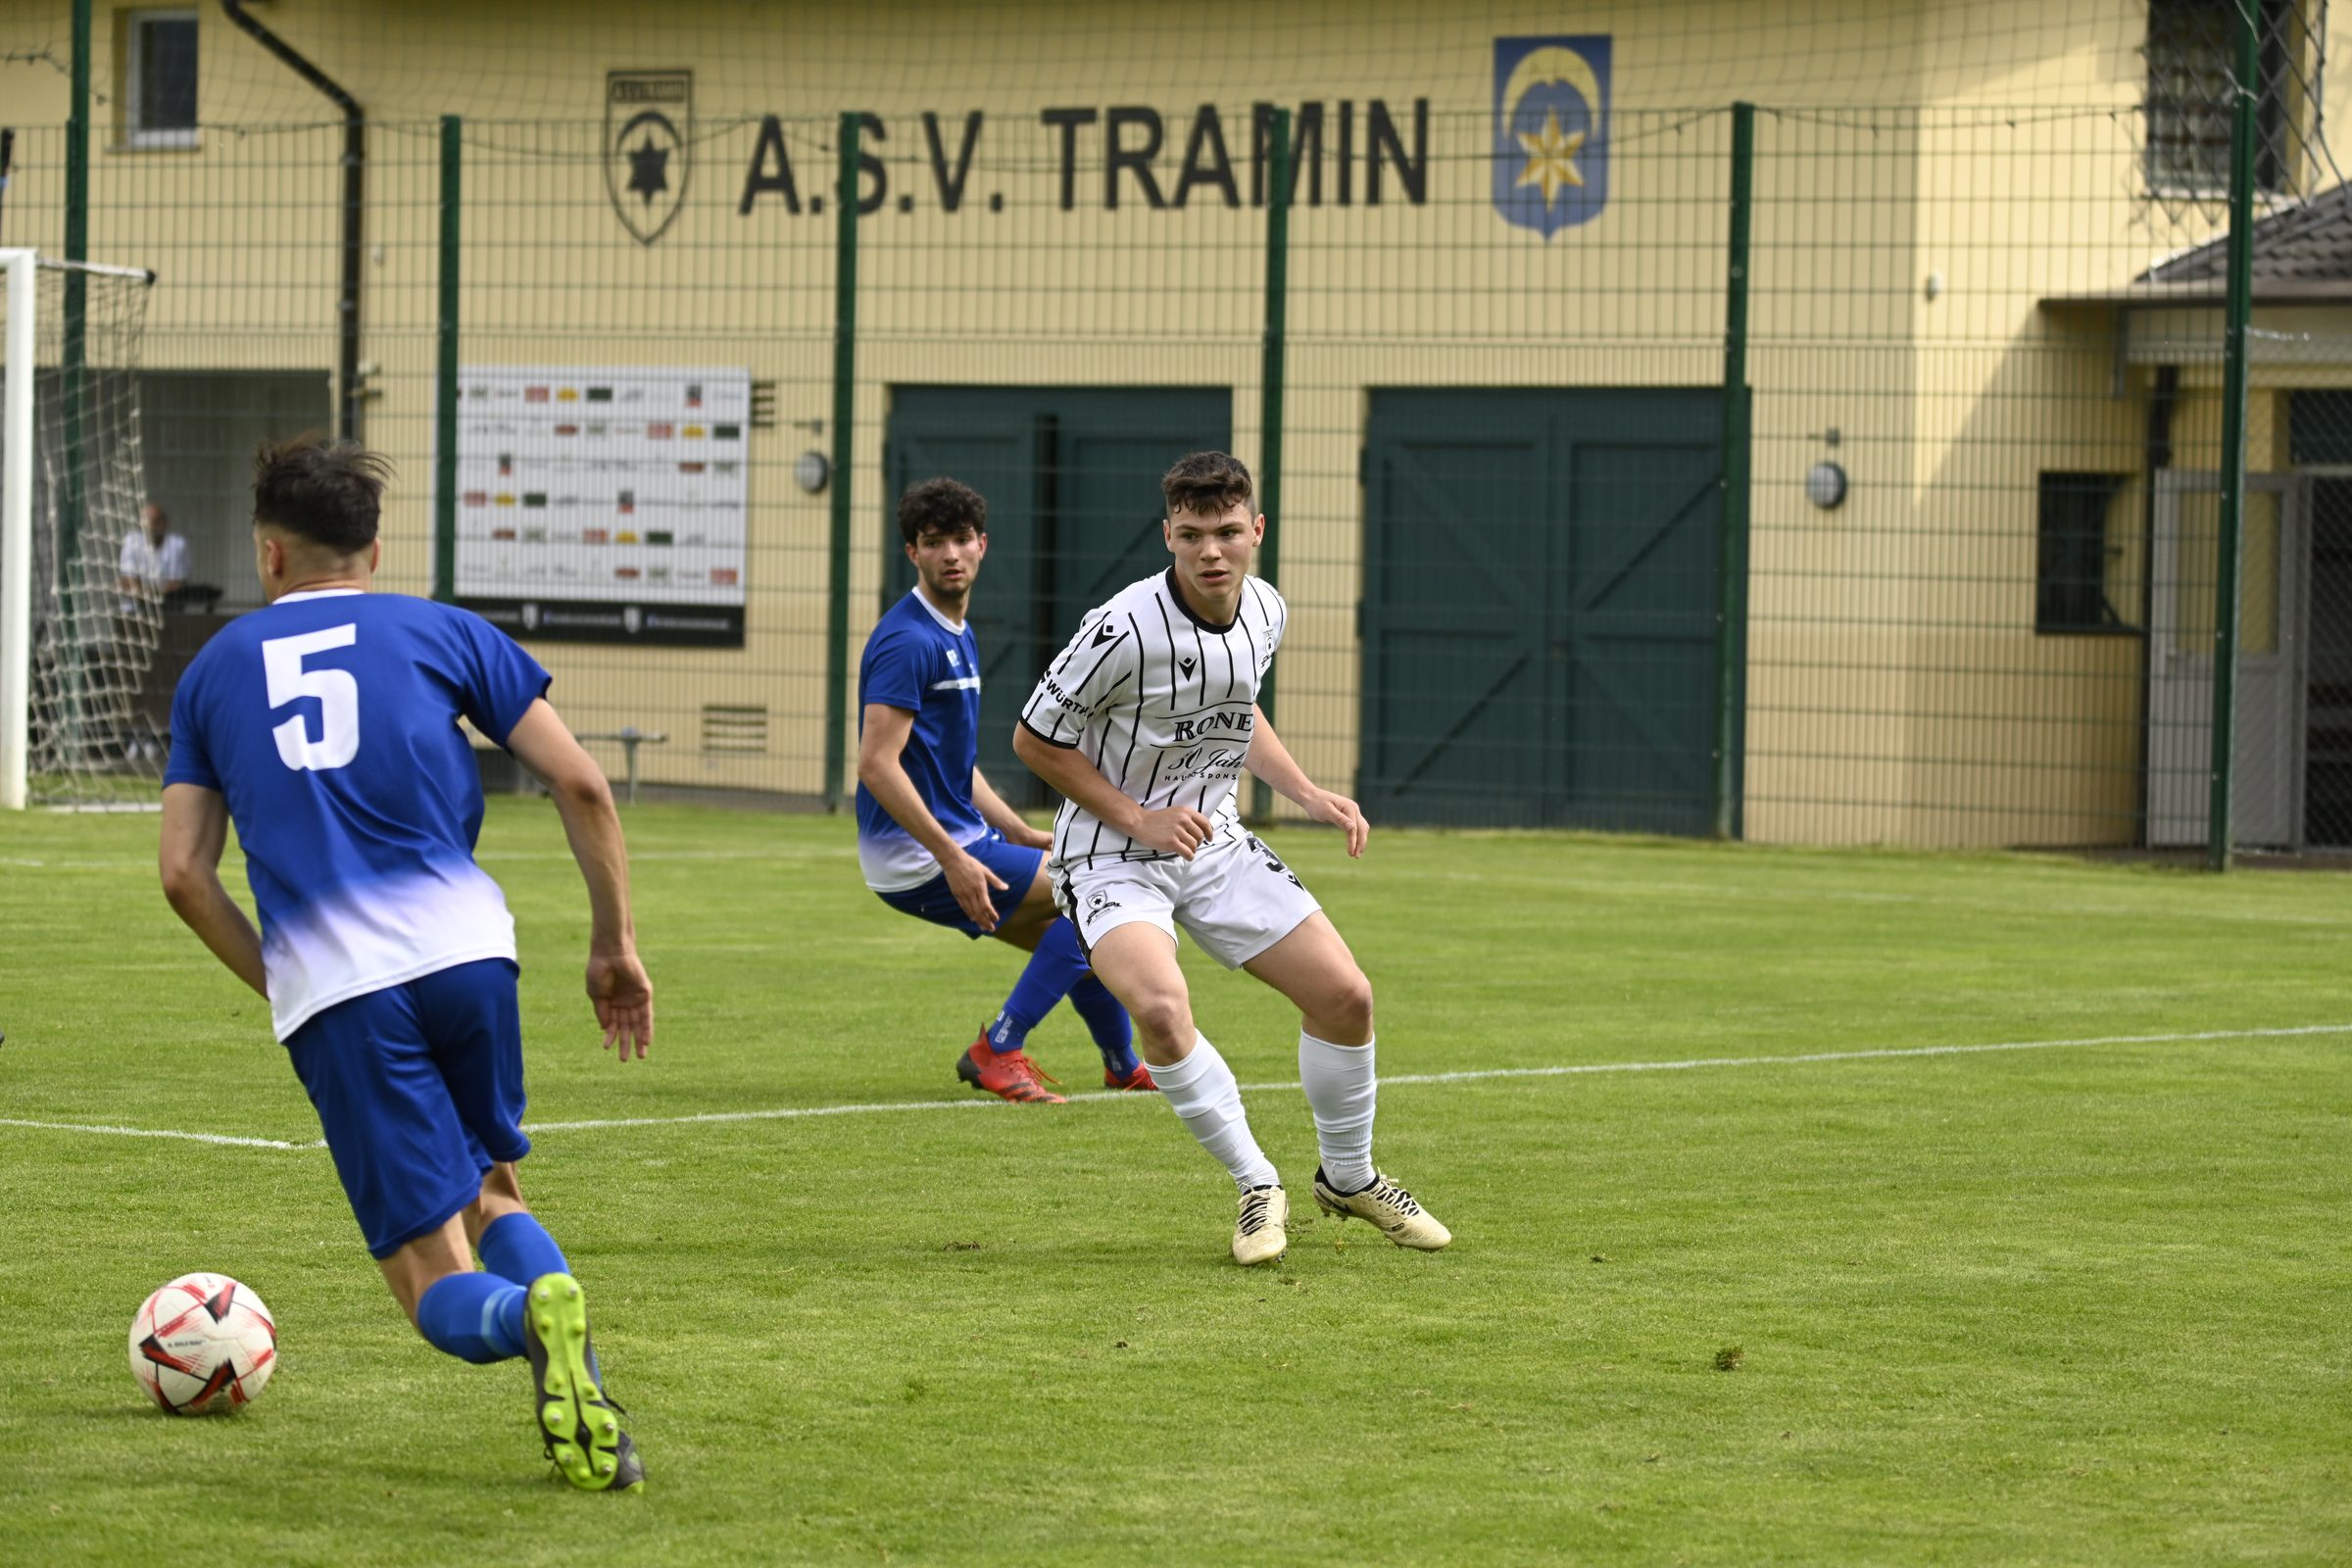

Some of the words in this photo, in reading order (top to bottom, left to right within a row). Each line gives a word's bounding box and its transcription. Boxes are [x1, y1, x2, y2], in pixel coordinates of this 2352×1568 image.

[738, 111, 1004, 214] A.S.V.
[1040, 99, 1429, 210] TRAMIN
[262, 622, 360, 771] 5
